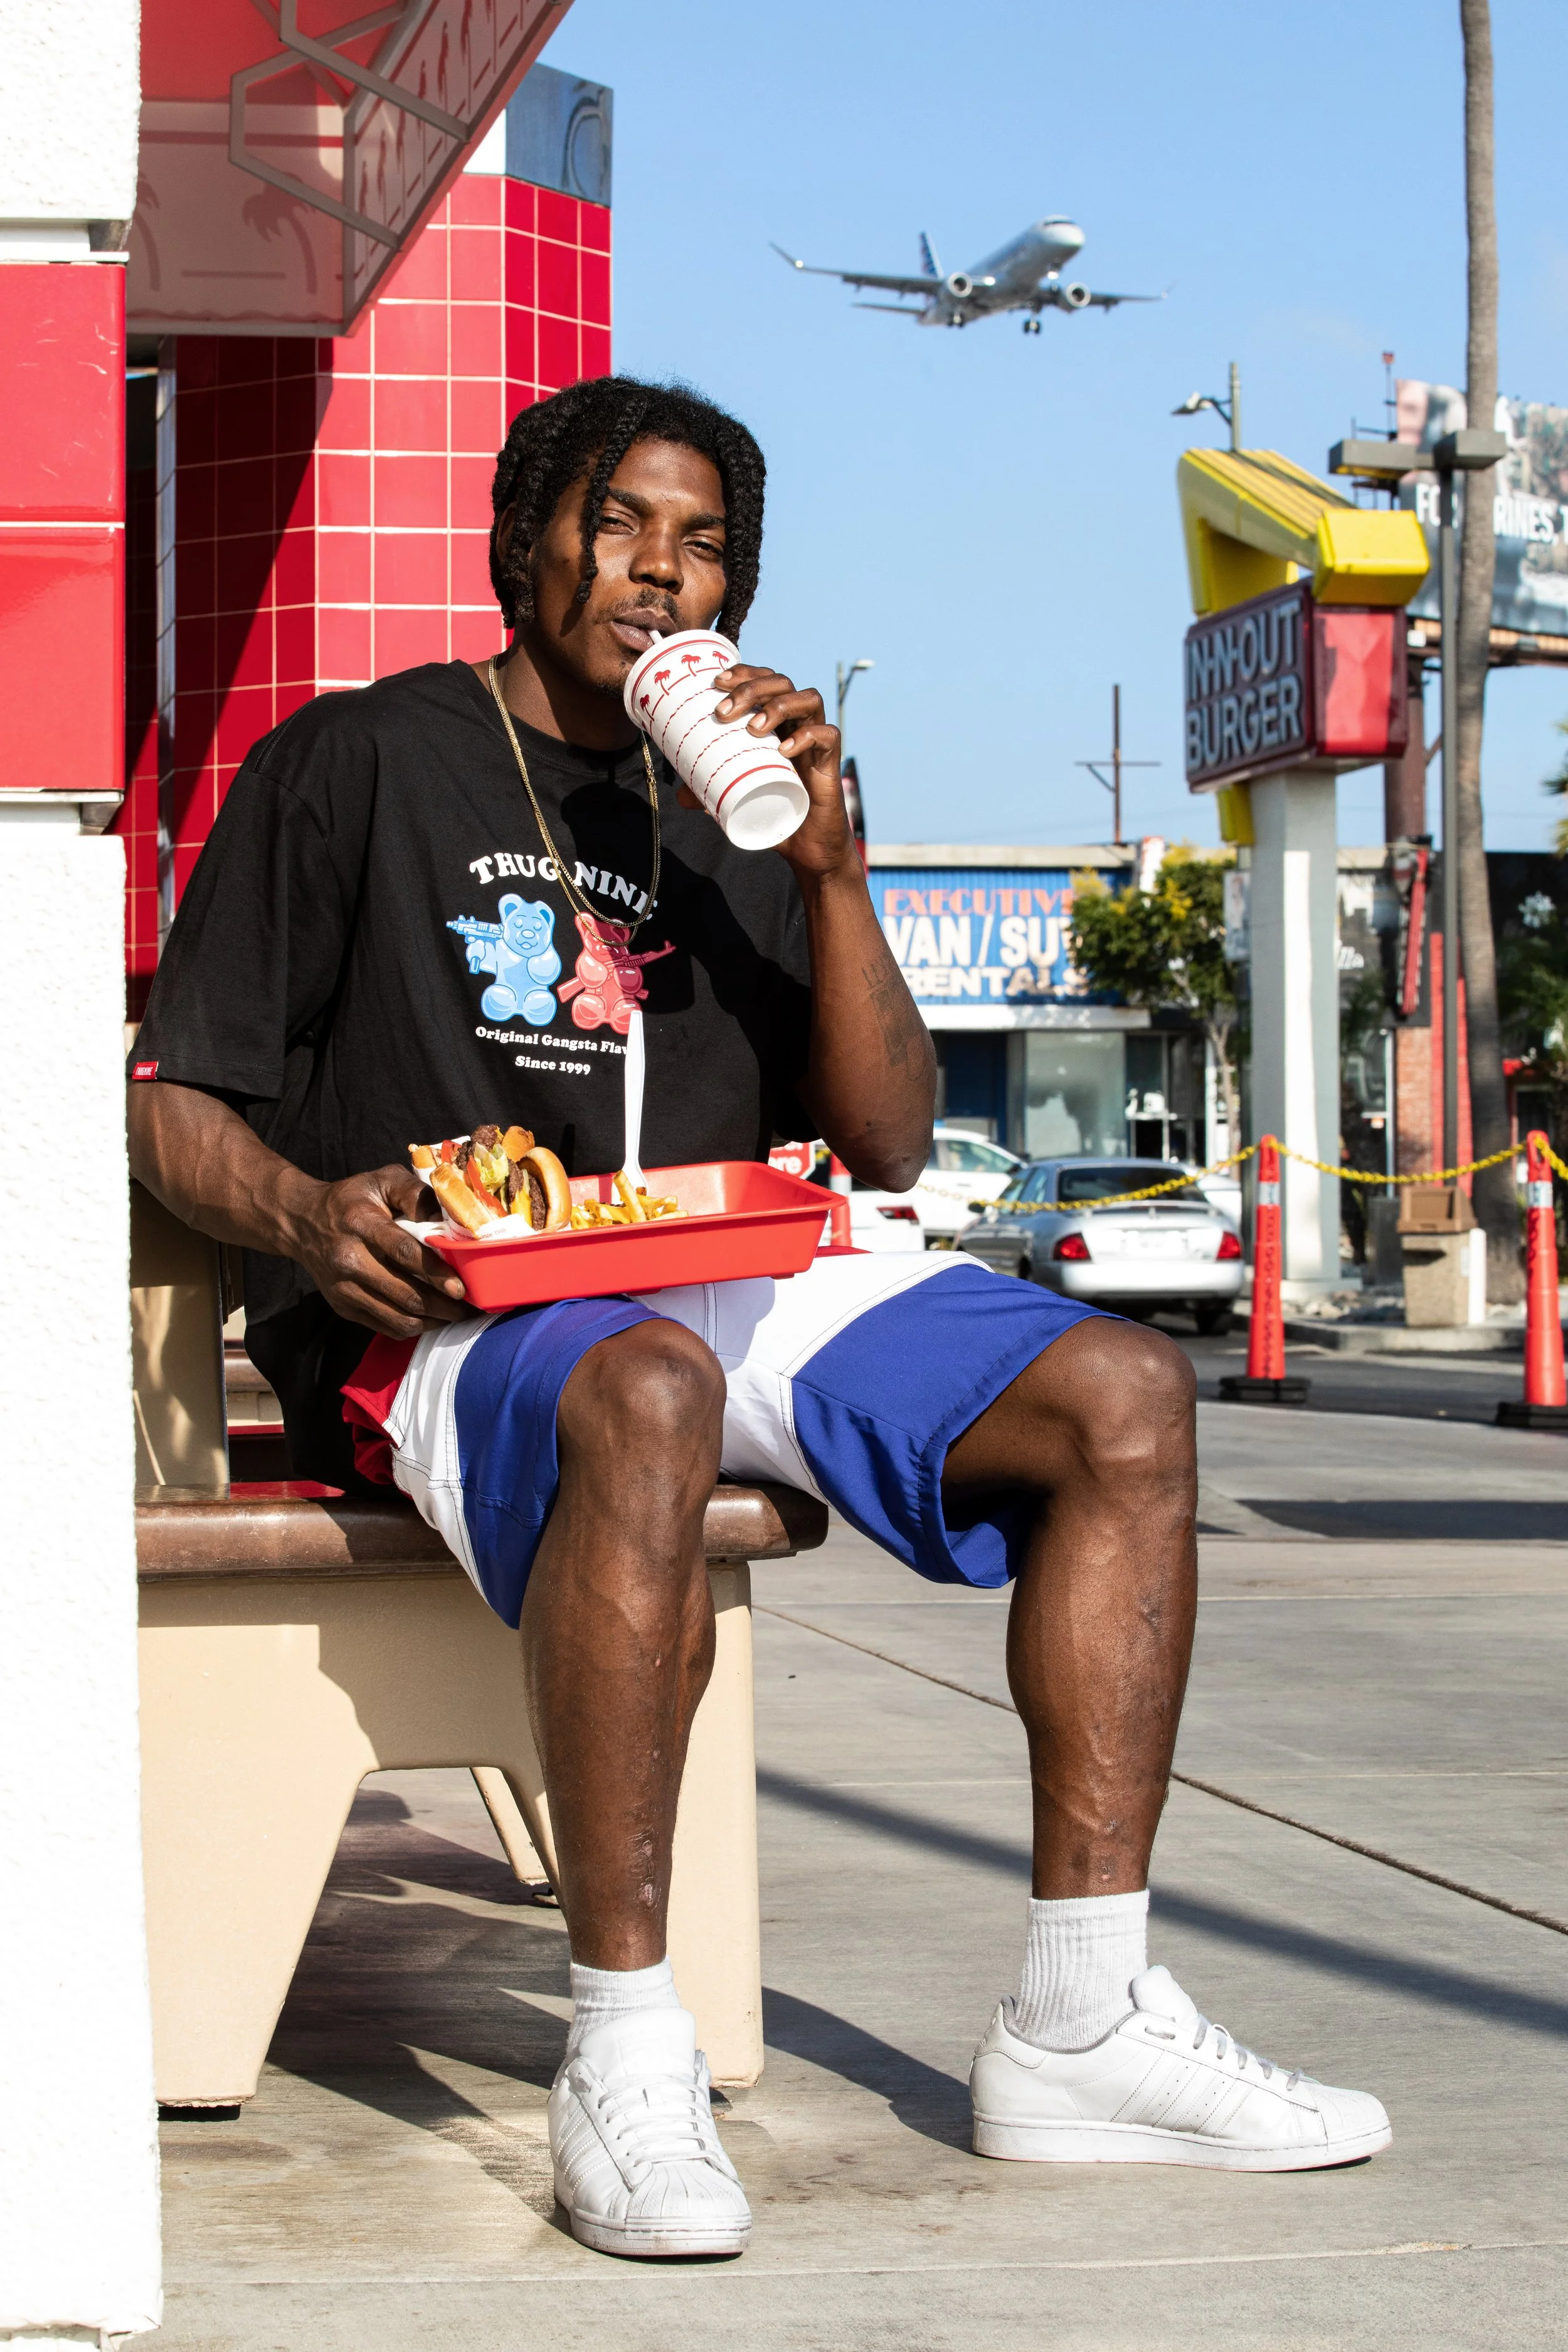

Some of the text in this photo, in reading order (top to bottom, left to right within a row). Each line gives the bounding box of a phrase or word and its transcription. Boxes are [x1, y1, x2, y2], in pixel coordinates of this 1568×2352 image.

[1186, 597, 1301, 703] IN-N-OUT
[1186, 674, 1301, 775] BURGER
[469, 852, 561, 884] THUG
[475, 1026, 627, 1055] Original Gangsta Flav
[515, 1056, 591, 1075] Since 1999
